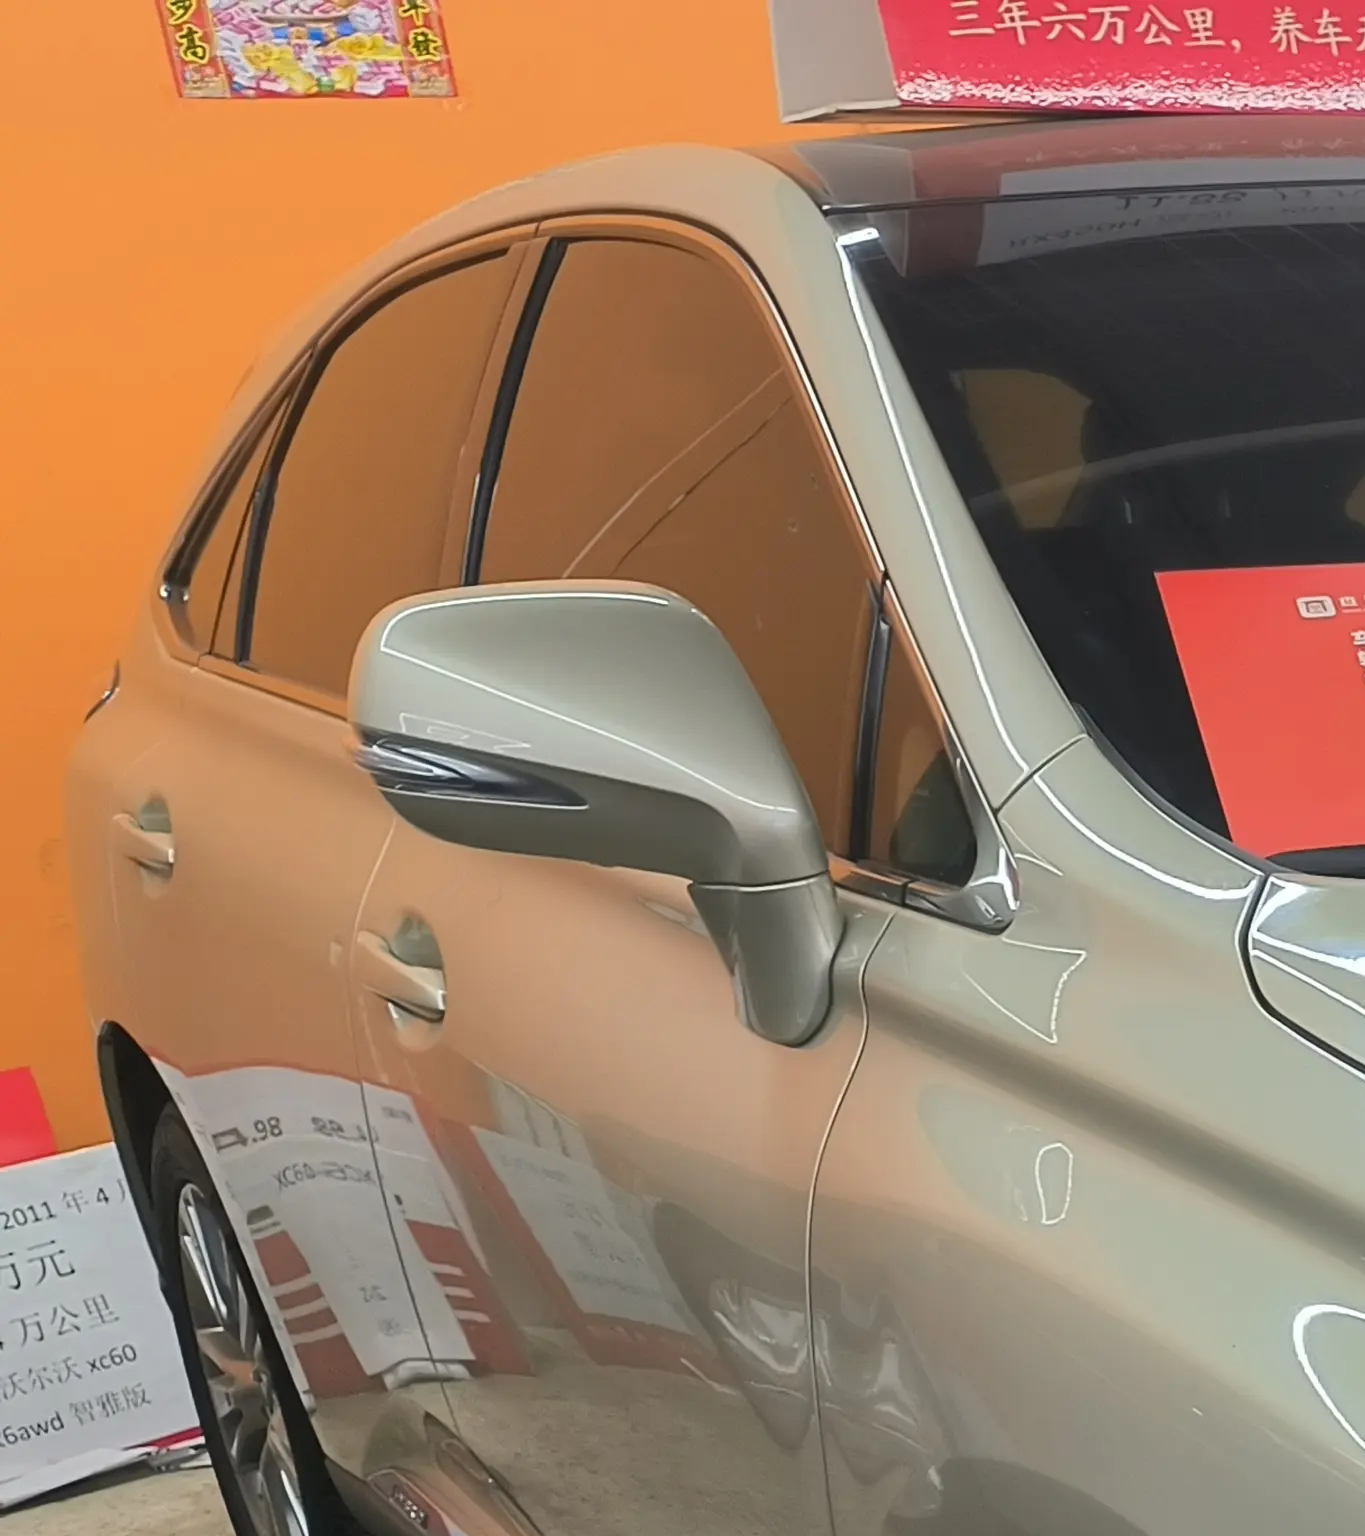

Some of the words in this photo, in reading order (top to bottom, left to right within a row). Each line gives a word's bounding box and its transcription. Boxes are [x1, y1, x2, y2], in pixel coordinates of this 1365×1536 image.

[0, 1201, 57, 1230] 2011
[61, 1189, 89, 1214] 年
[96, 1187, 110, 1205] 4
[9, 1294, 120, 1347] 万公里
[86, 1343, 138, 1374] xc60
[69, 1382, 152, 1427] 智雅版
